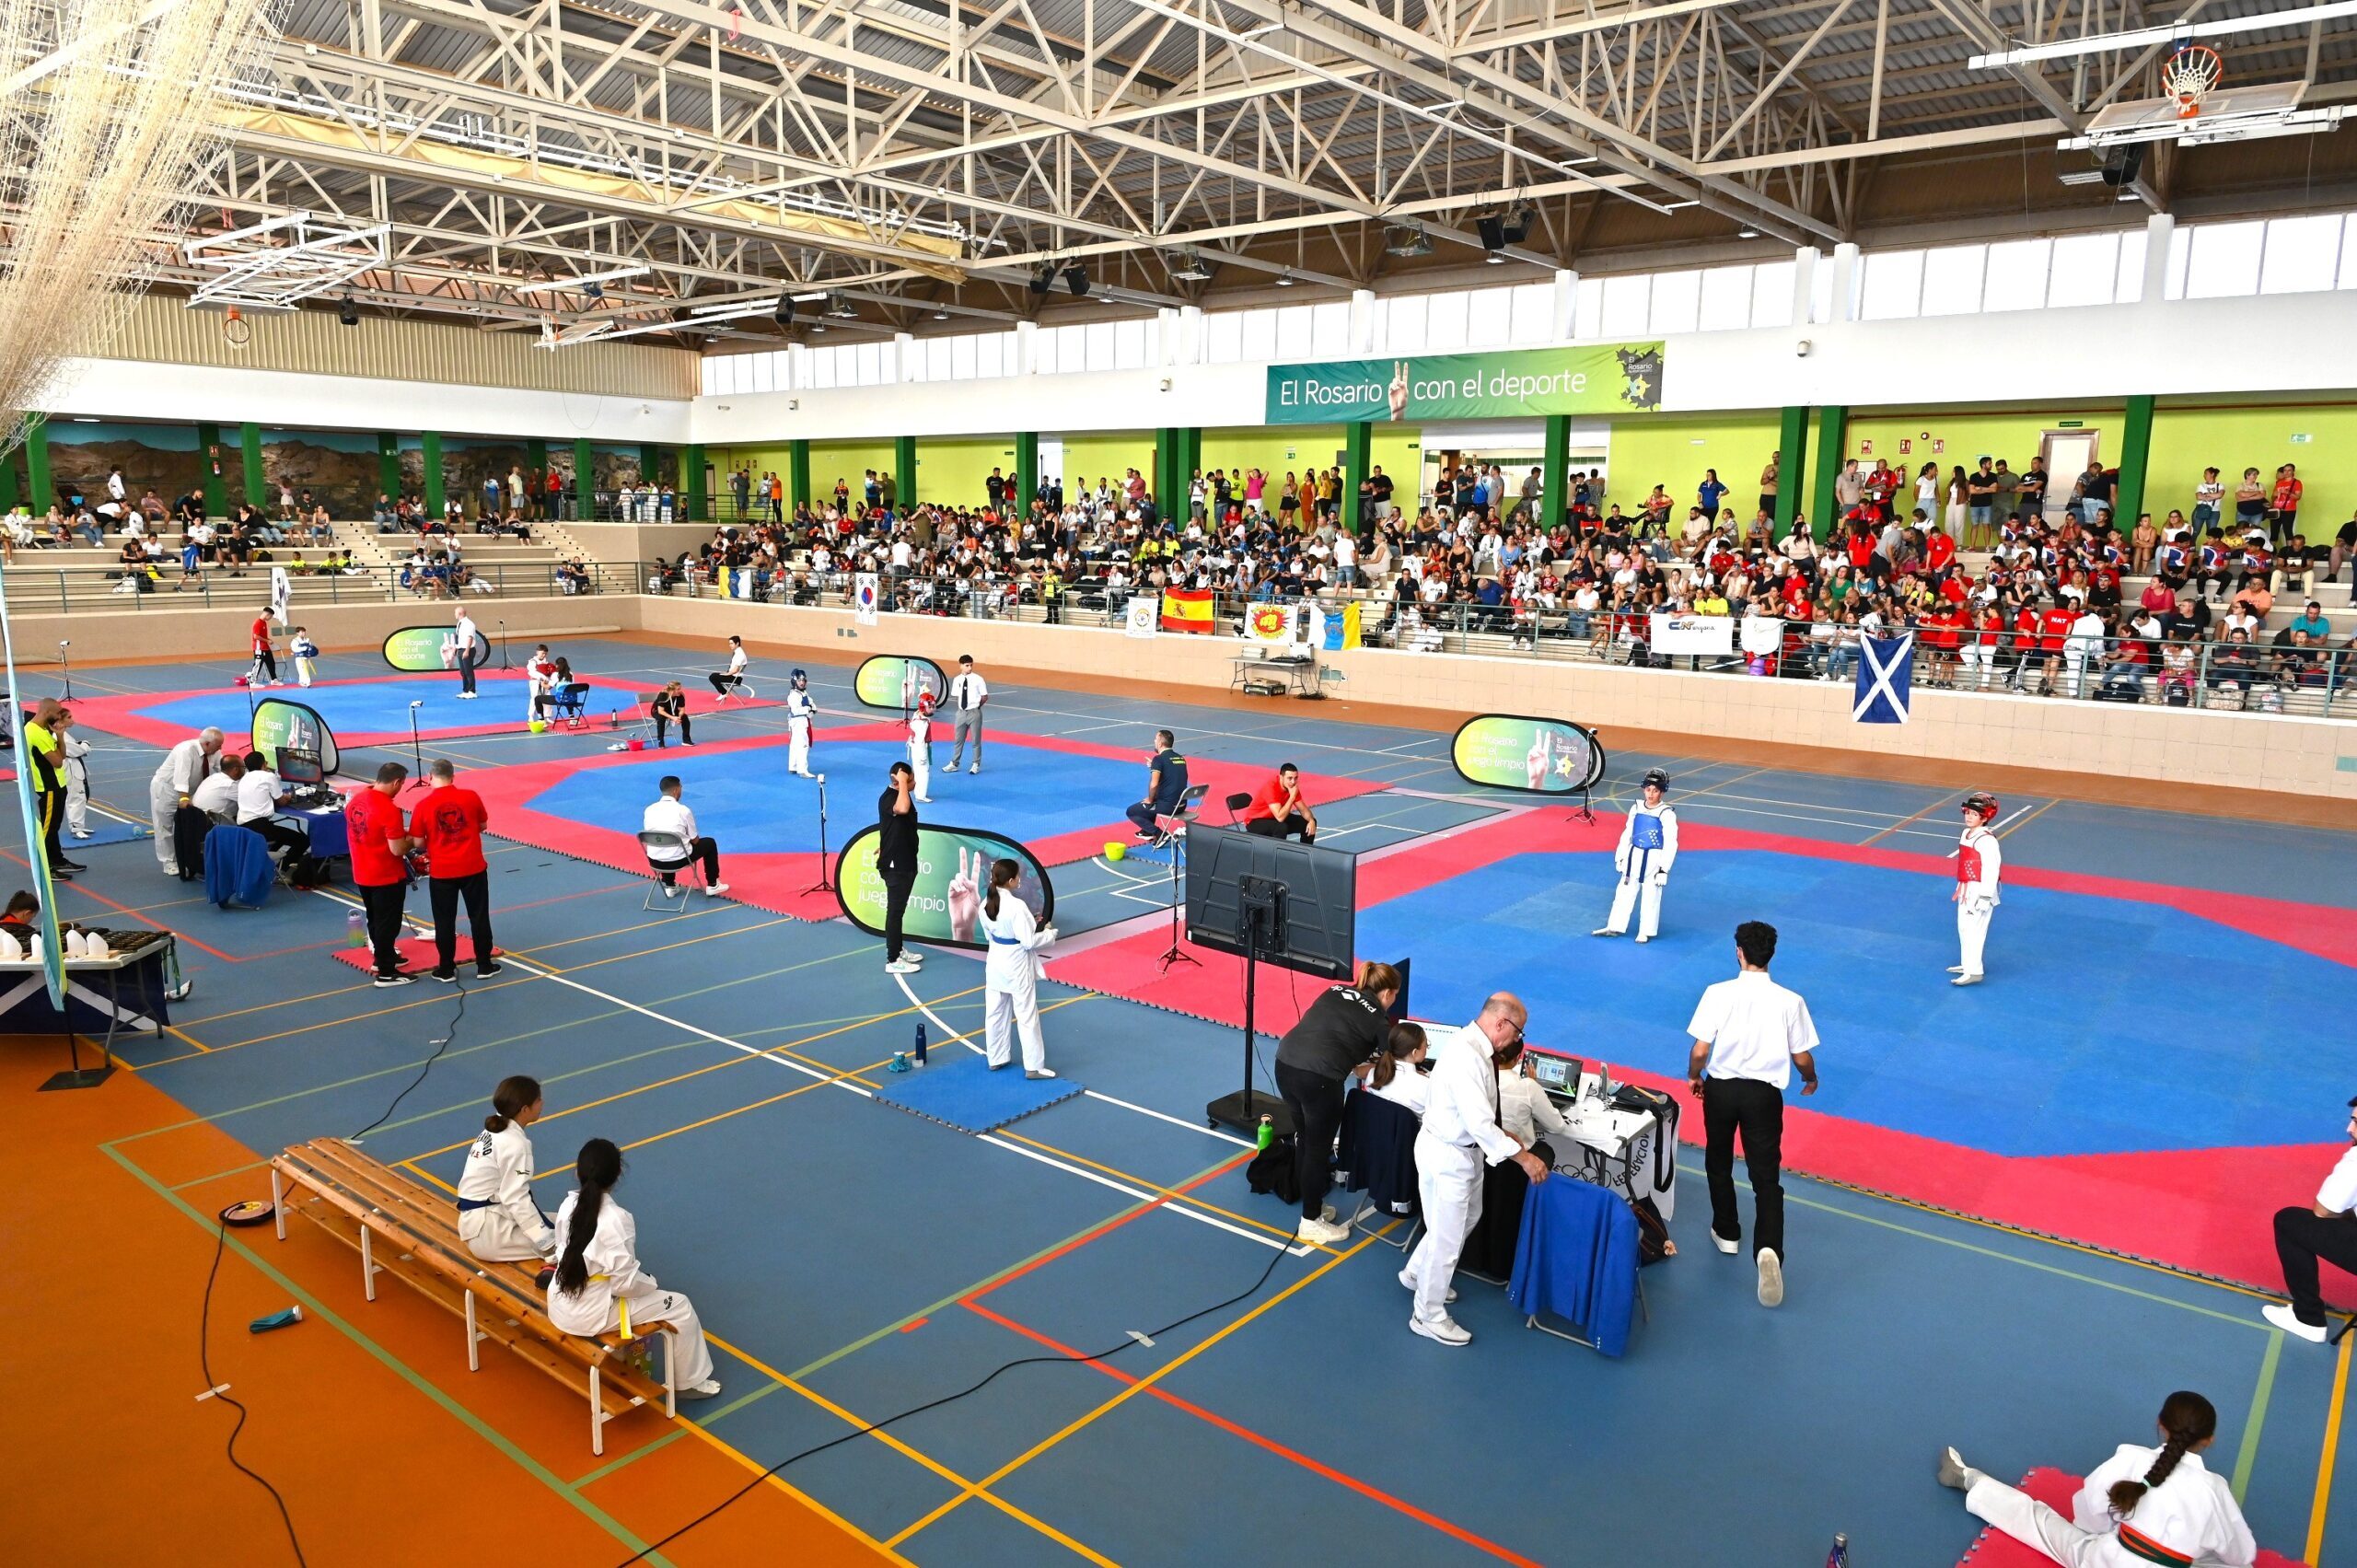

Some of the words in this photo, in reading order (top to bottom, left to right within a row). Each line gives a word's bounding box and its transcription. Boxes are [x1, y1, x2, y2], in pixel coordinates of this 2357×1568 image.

[1281, 379, 1299, 405] El
[1306, 378, 1382, 405] Rosario
[1414, 379, 1456, 401] con
[1462, 369, 1483, 398] el
[1490, 367, 1586, 402] deporte
[2050, 616, 2068, 624] NAT
[405, 638, 433, 647] Rosario
[397, 652, 425, 661] deporte
[266, 717, 284, 731] Rosario
[260, 729, 269, 738] con
[270, 727, 274, 739] el
[1483, 732, 1517, 747] Rosario
[260, 738, 277, 752] deport
[1494, 758, 1526, 771] limpio
[857, 886, 888, 909] jueg
